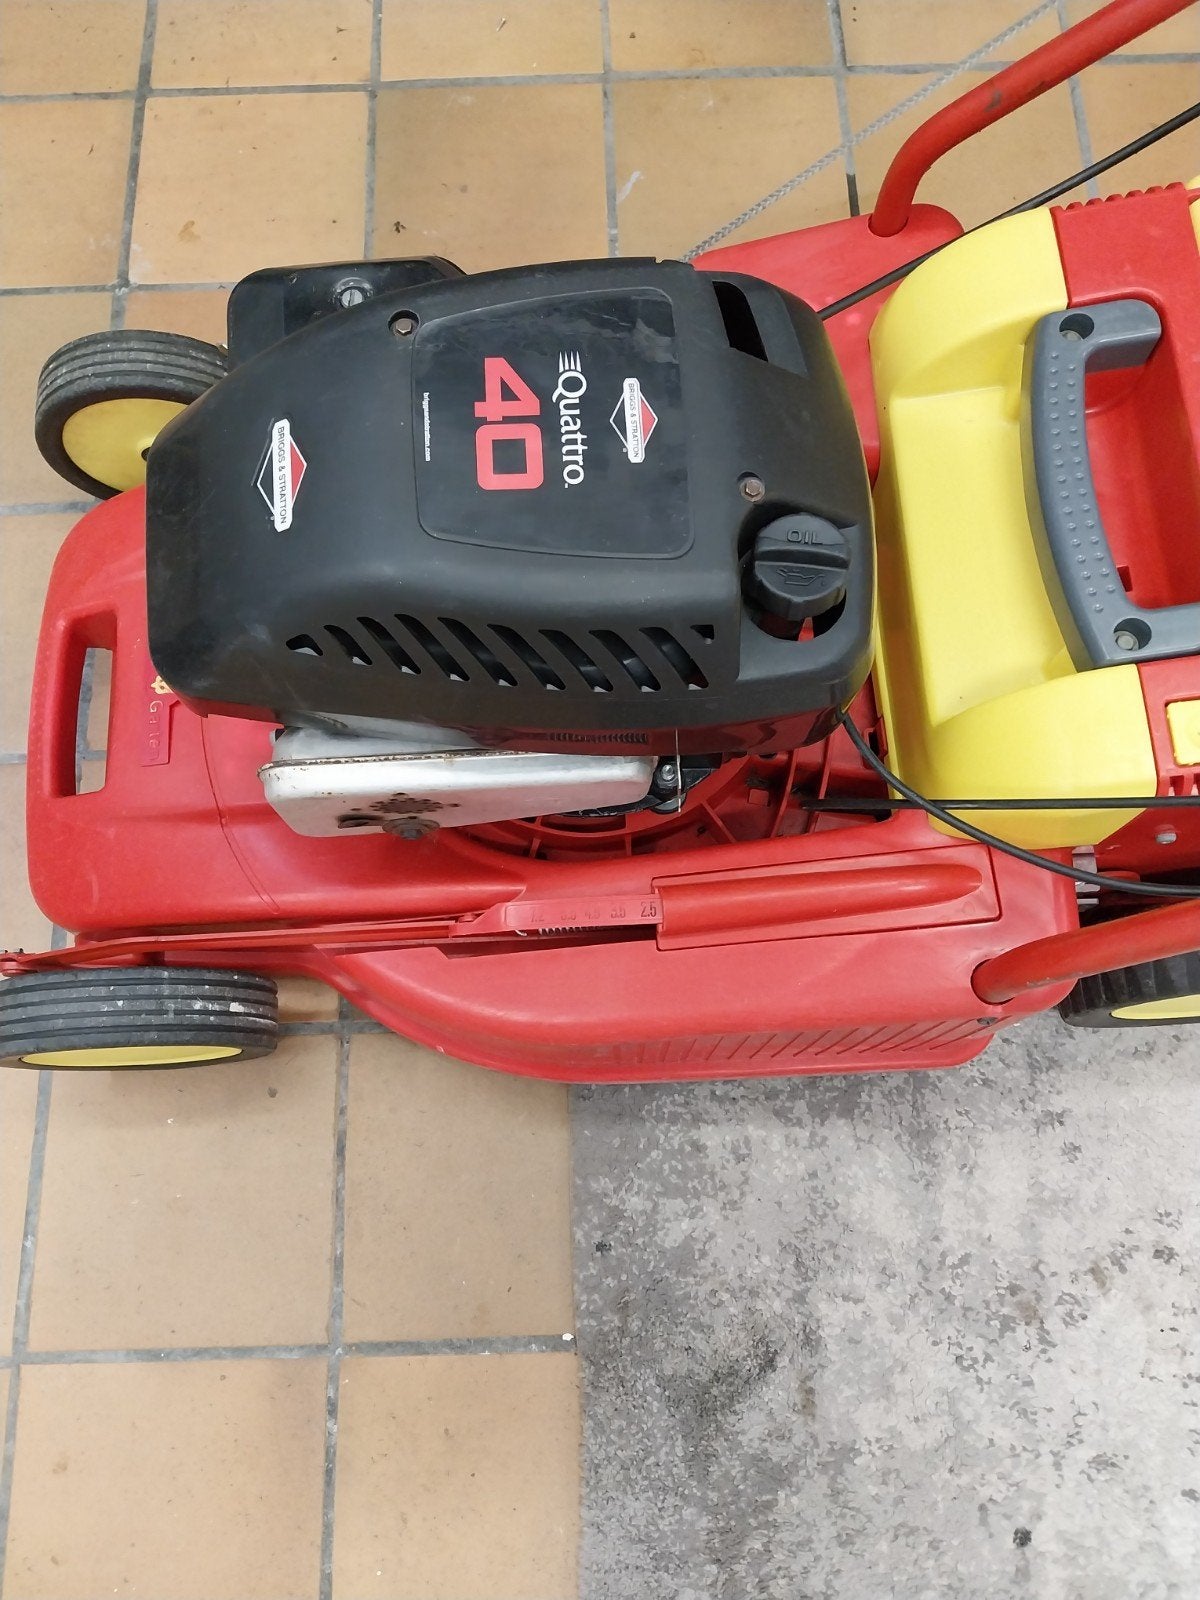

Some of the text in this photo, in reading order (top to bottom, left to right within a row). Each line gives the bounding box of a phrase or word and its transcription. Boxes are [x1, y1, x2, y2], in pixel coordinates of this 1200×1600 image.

[474, 357, 544, 490] 40
[552, 371, 588, 485] Quattro
[630, 420, 639, 458] STRATTON
[787, 529, 823, 545] OIL
[640, 901, 657, 918] 2.5
